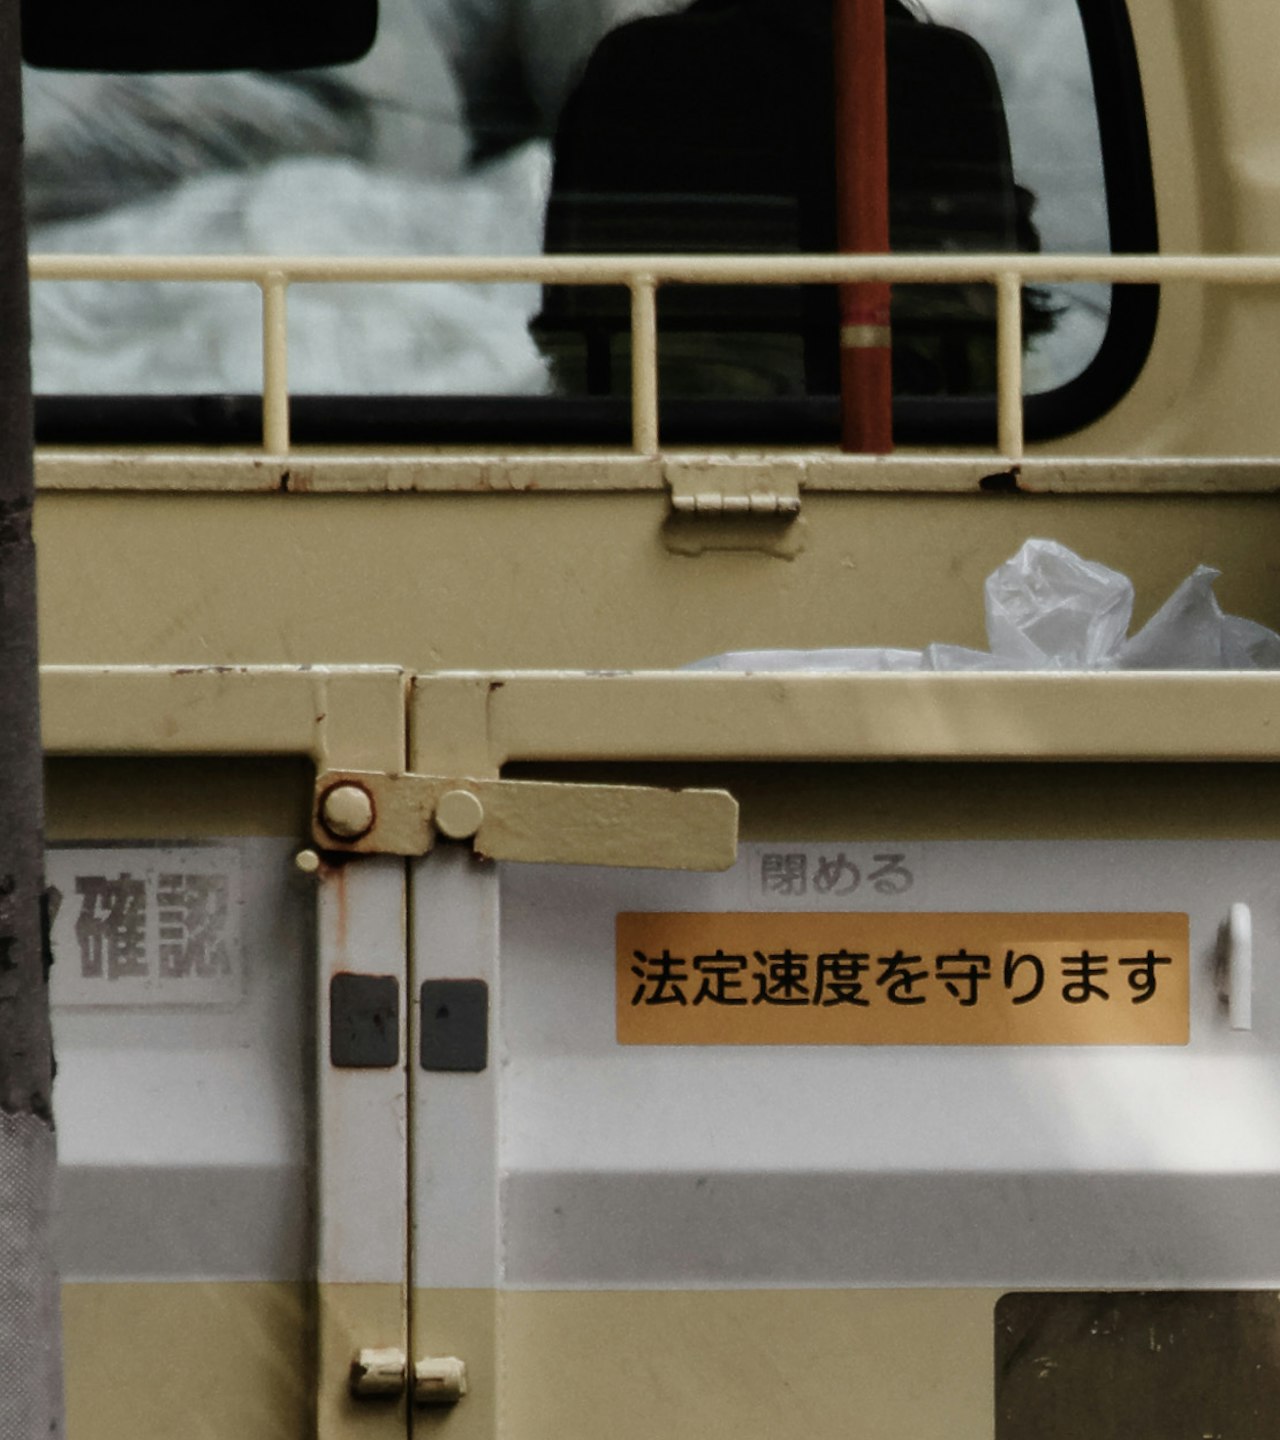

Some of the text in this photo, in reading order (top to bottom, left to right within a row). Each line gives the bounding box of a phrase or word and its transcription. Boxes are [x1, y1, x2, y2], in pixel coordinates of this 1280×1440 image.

[761, 852, 914, 897] 閉める
[75, 872, 233, 980] 確認
[630, 947, 1173, 1007] 法定速度を守ります
